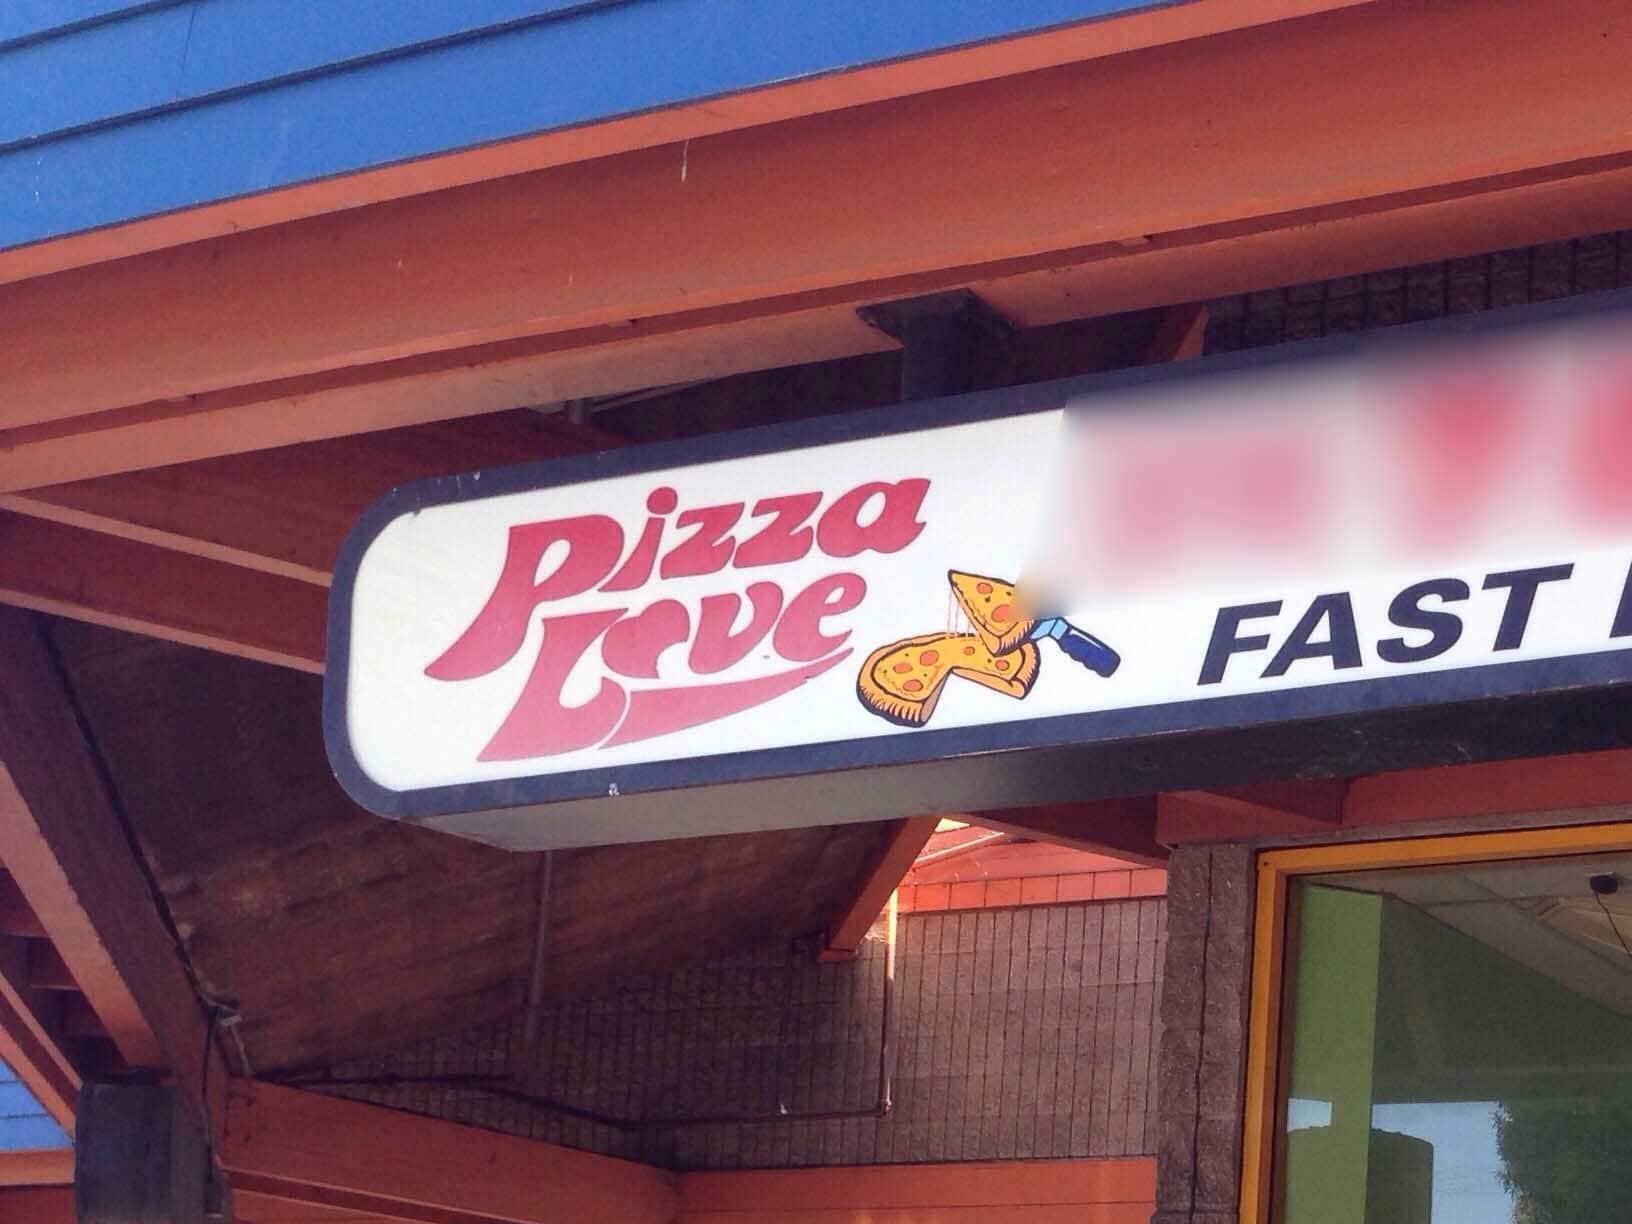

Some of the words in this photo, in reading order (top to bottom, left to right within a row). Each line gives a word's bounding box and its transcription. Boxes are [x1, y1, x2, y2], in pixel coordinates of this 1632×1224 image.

[424, 478, 932, 681] Pizza
[476, 571, 868, 763] Love
[1197, 562, 1574, 686] FAST
